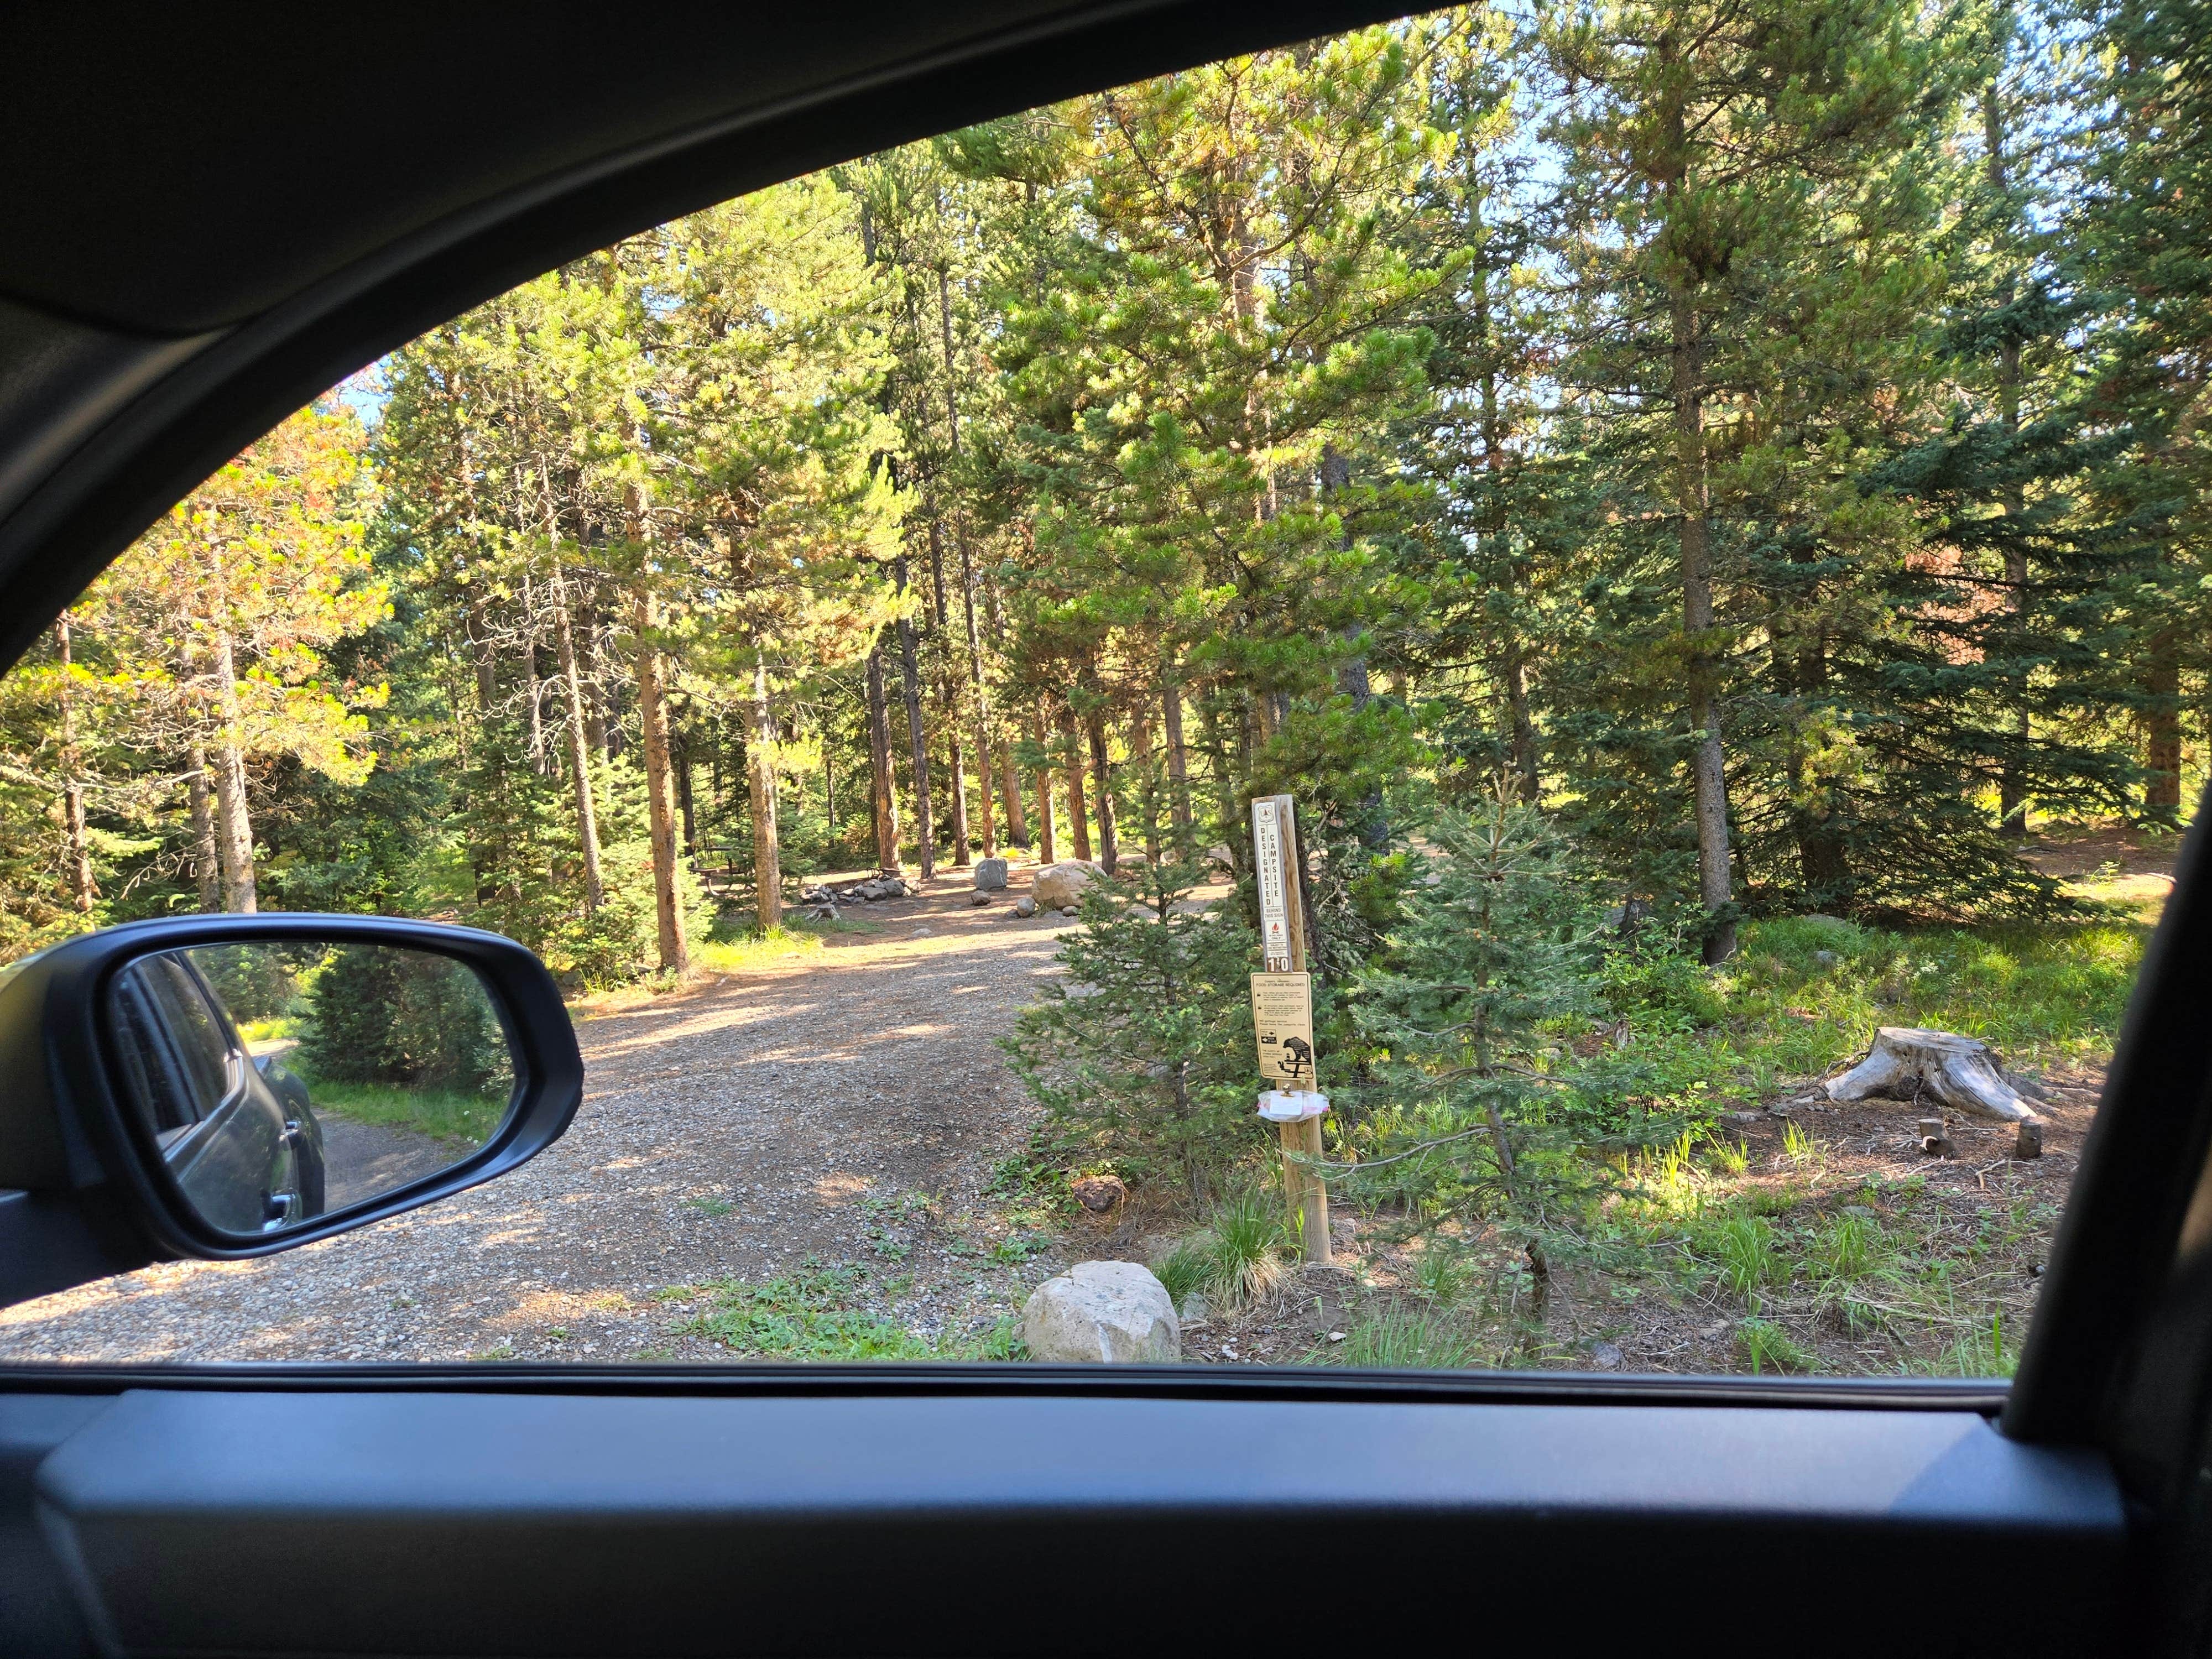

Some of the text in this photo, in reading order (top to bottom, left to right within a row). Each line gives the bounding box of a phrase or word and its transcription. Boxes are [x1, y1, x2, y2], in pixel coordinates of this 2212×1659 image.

[1261, 827, 1271, 905] DESIGNATED
[1270, 834, 1279, 896] CAMPSITE
[1268, 957, 1288, 972] 10
